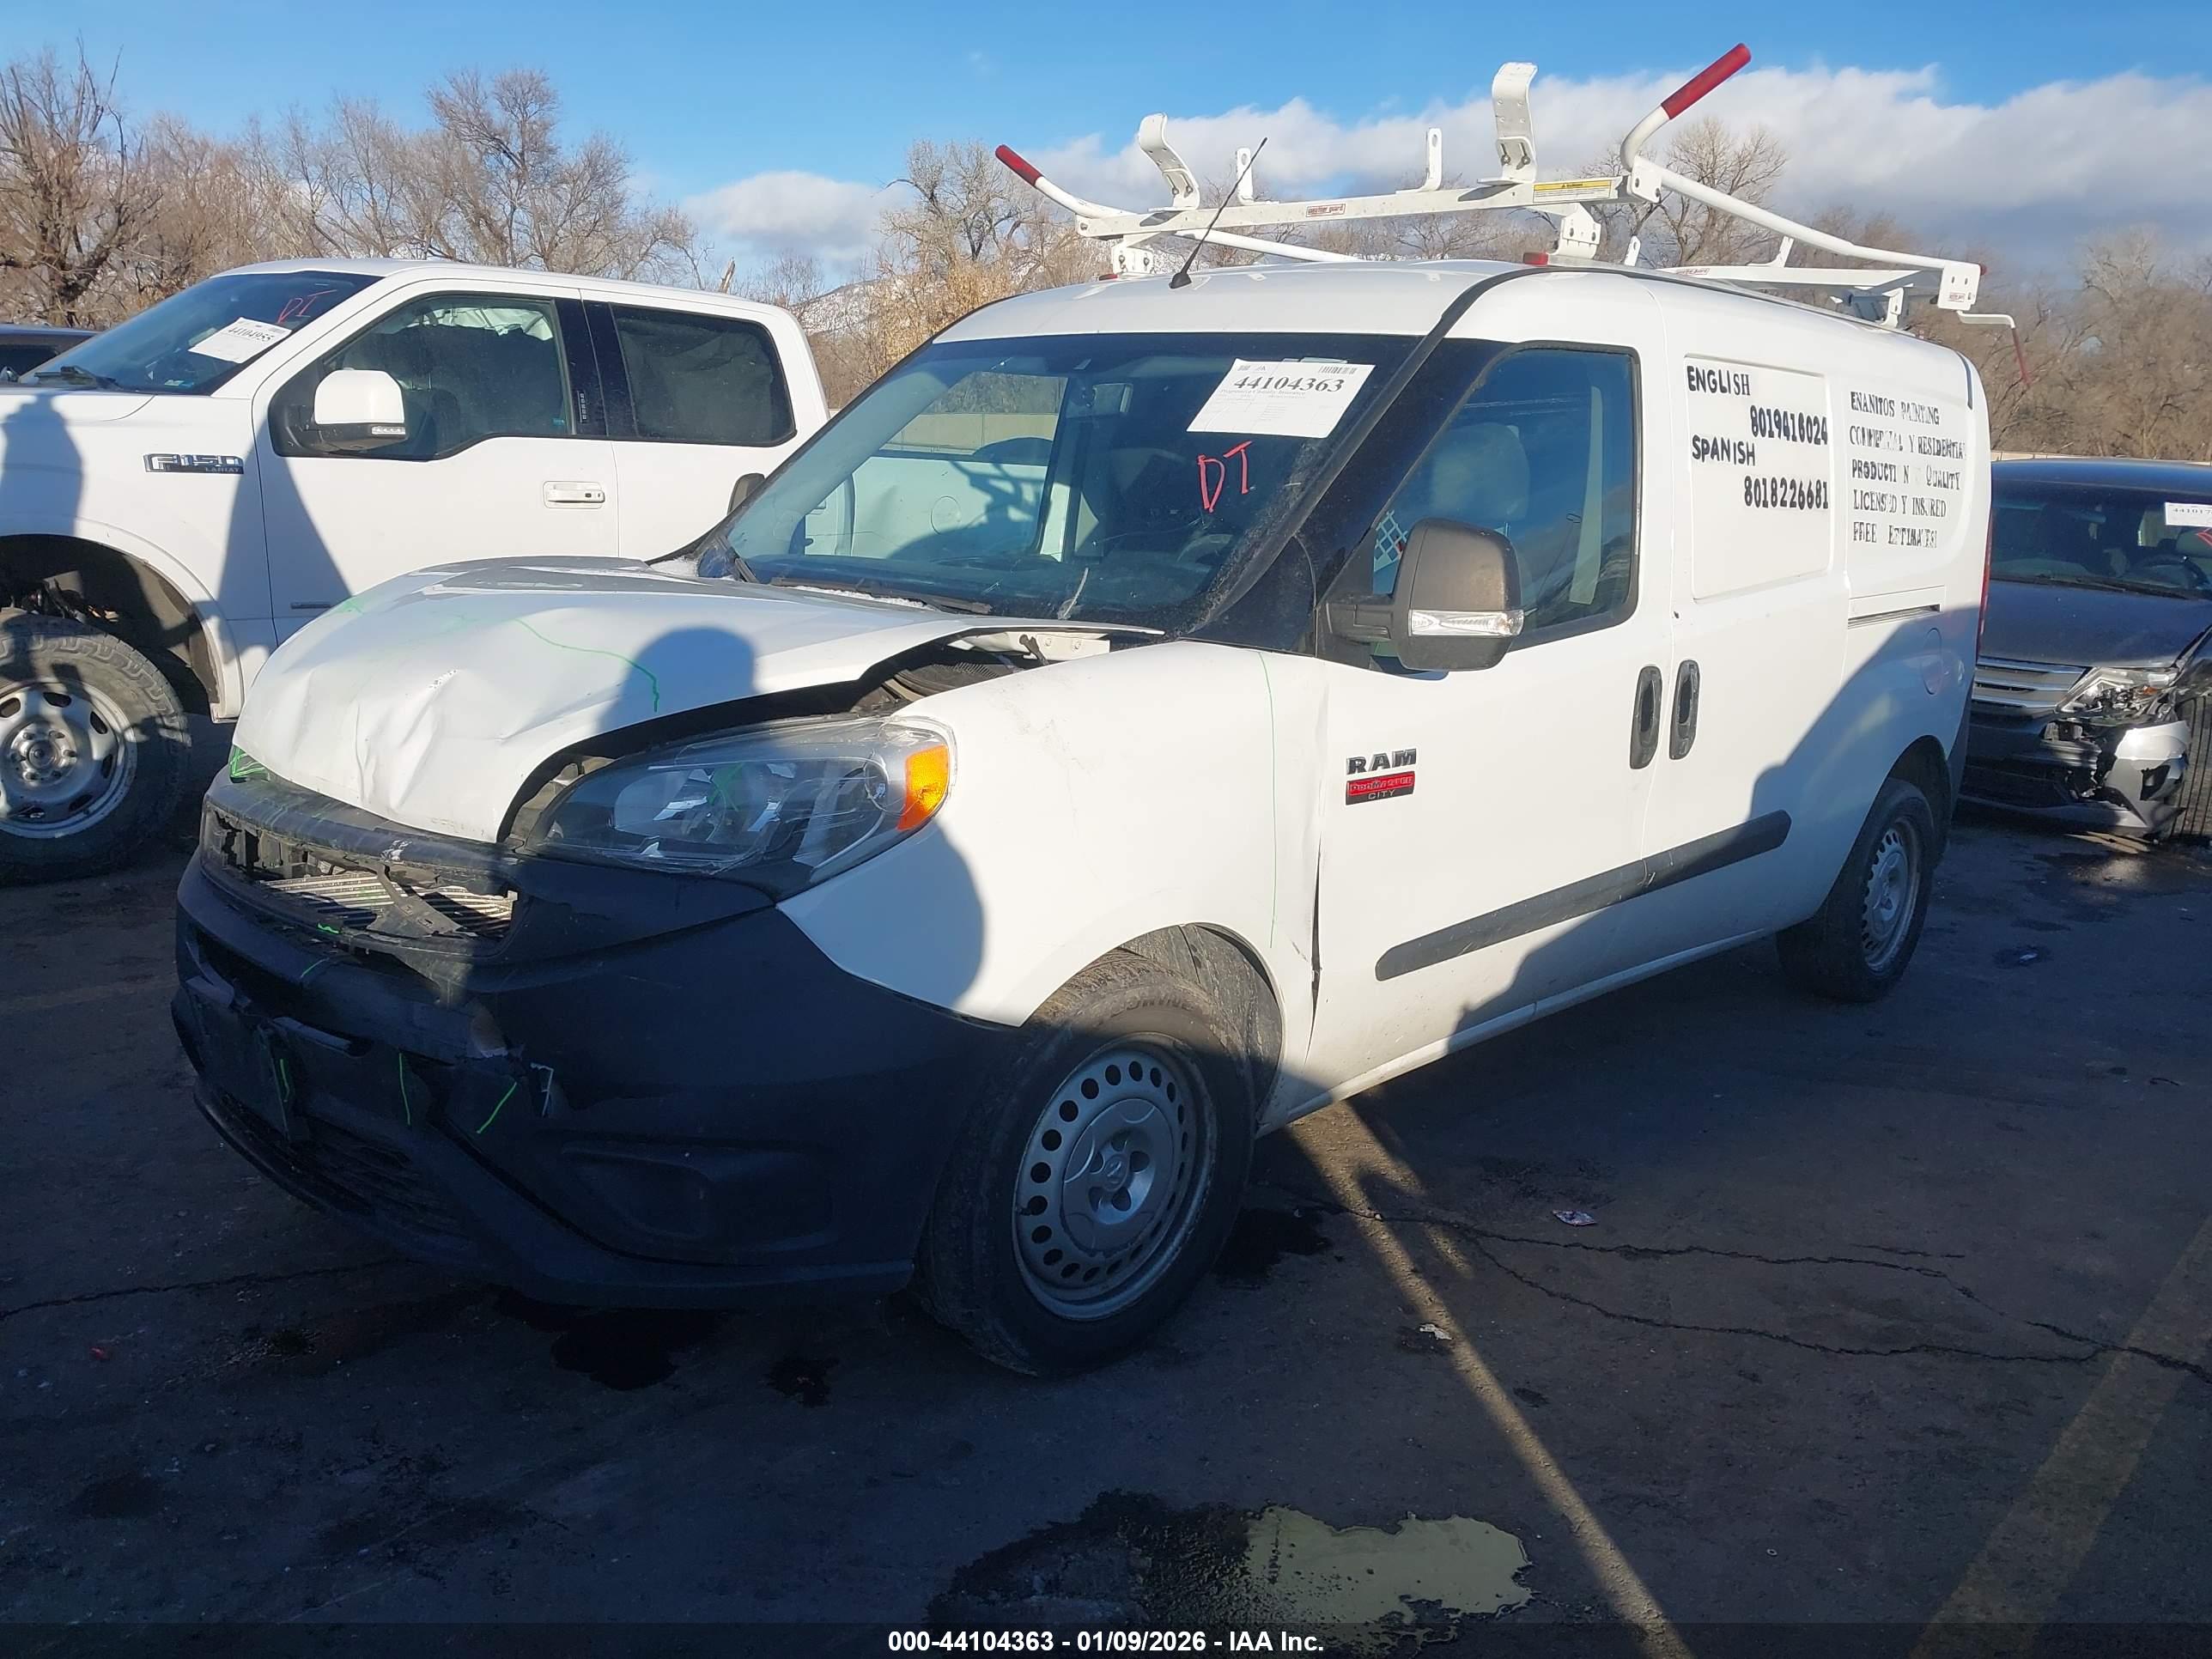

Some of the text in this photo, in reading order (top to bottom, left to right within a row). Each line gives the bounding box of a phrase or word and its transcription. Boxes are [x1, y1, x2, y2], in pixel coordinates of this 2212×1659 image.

[1234, 376, 1345, 392] 44104363
[1686, 365, 1751, 396] ENGLISH
[1850, 392, 1895, 417] ENANITOS
[1692, 434, 1756, 466] SPANISH
[1909, 434, 1916, 453] Y
[1918, 435, 1966, 460] RESIDENTIA
[1197, 440, 1253, 514] DT
[1851, 459, 1960, 490] PRODUCTIN QUALITY
[1744, 476, 1829, 510] 8018226681
[1853, 489, 1898, 514] LICENSD
[1901, 495, 1908, 515] Y
[1346, 748, 1417, 775] RAM
[1368, 789, 1396, 800] CITY
